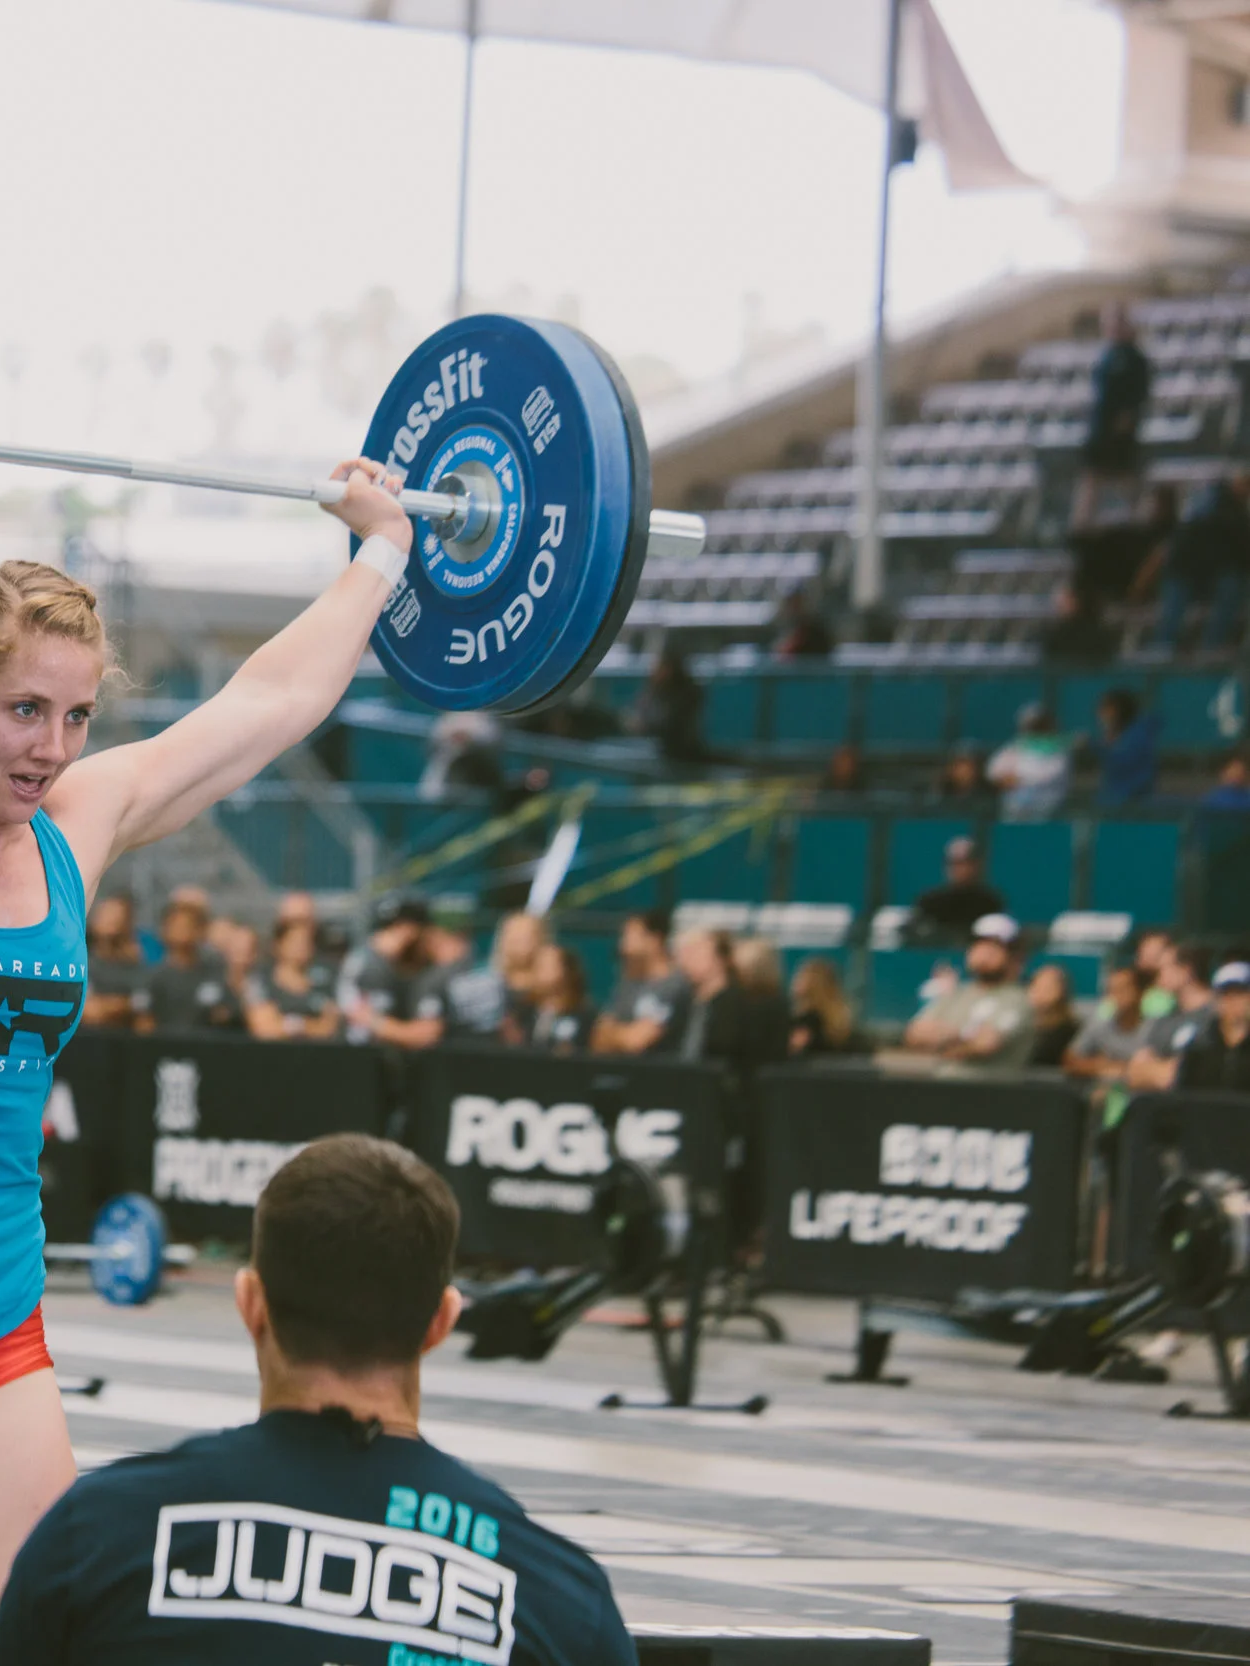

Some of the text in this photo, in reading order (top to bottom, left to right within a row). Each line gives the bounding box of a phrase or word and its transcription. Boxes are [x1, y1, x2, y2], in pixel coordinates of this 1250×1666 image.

[386, 348, 485, 484] rossFit
[447, 504, 567, 665] ROGUE
[169, 1518, 500, 1644] JUDGE
[385, 1485, 499, 1560] 2016
